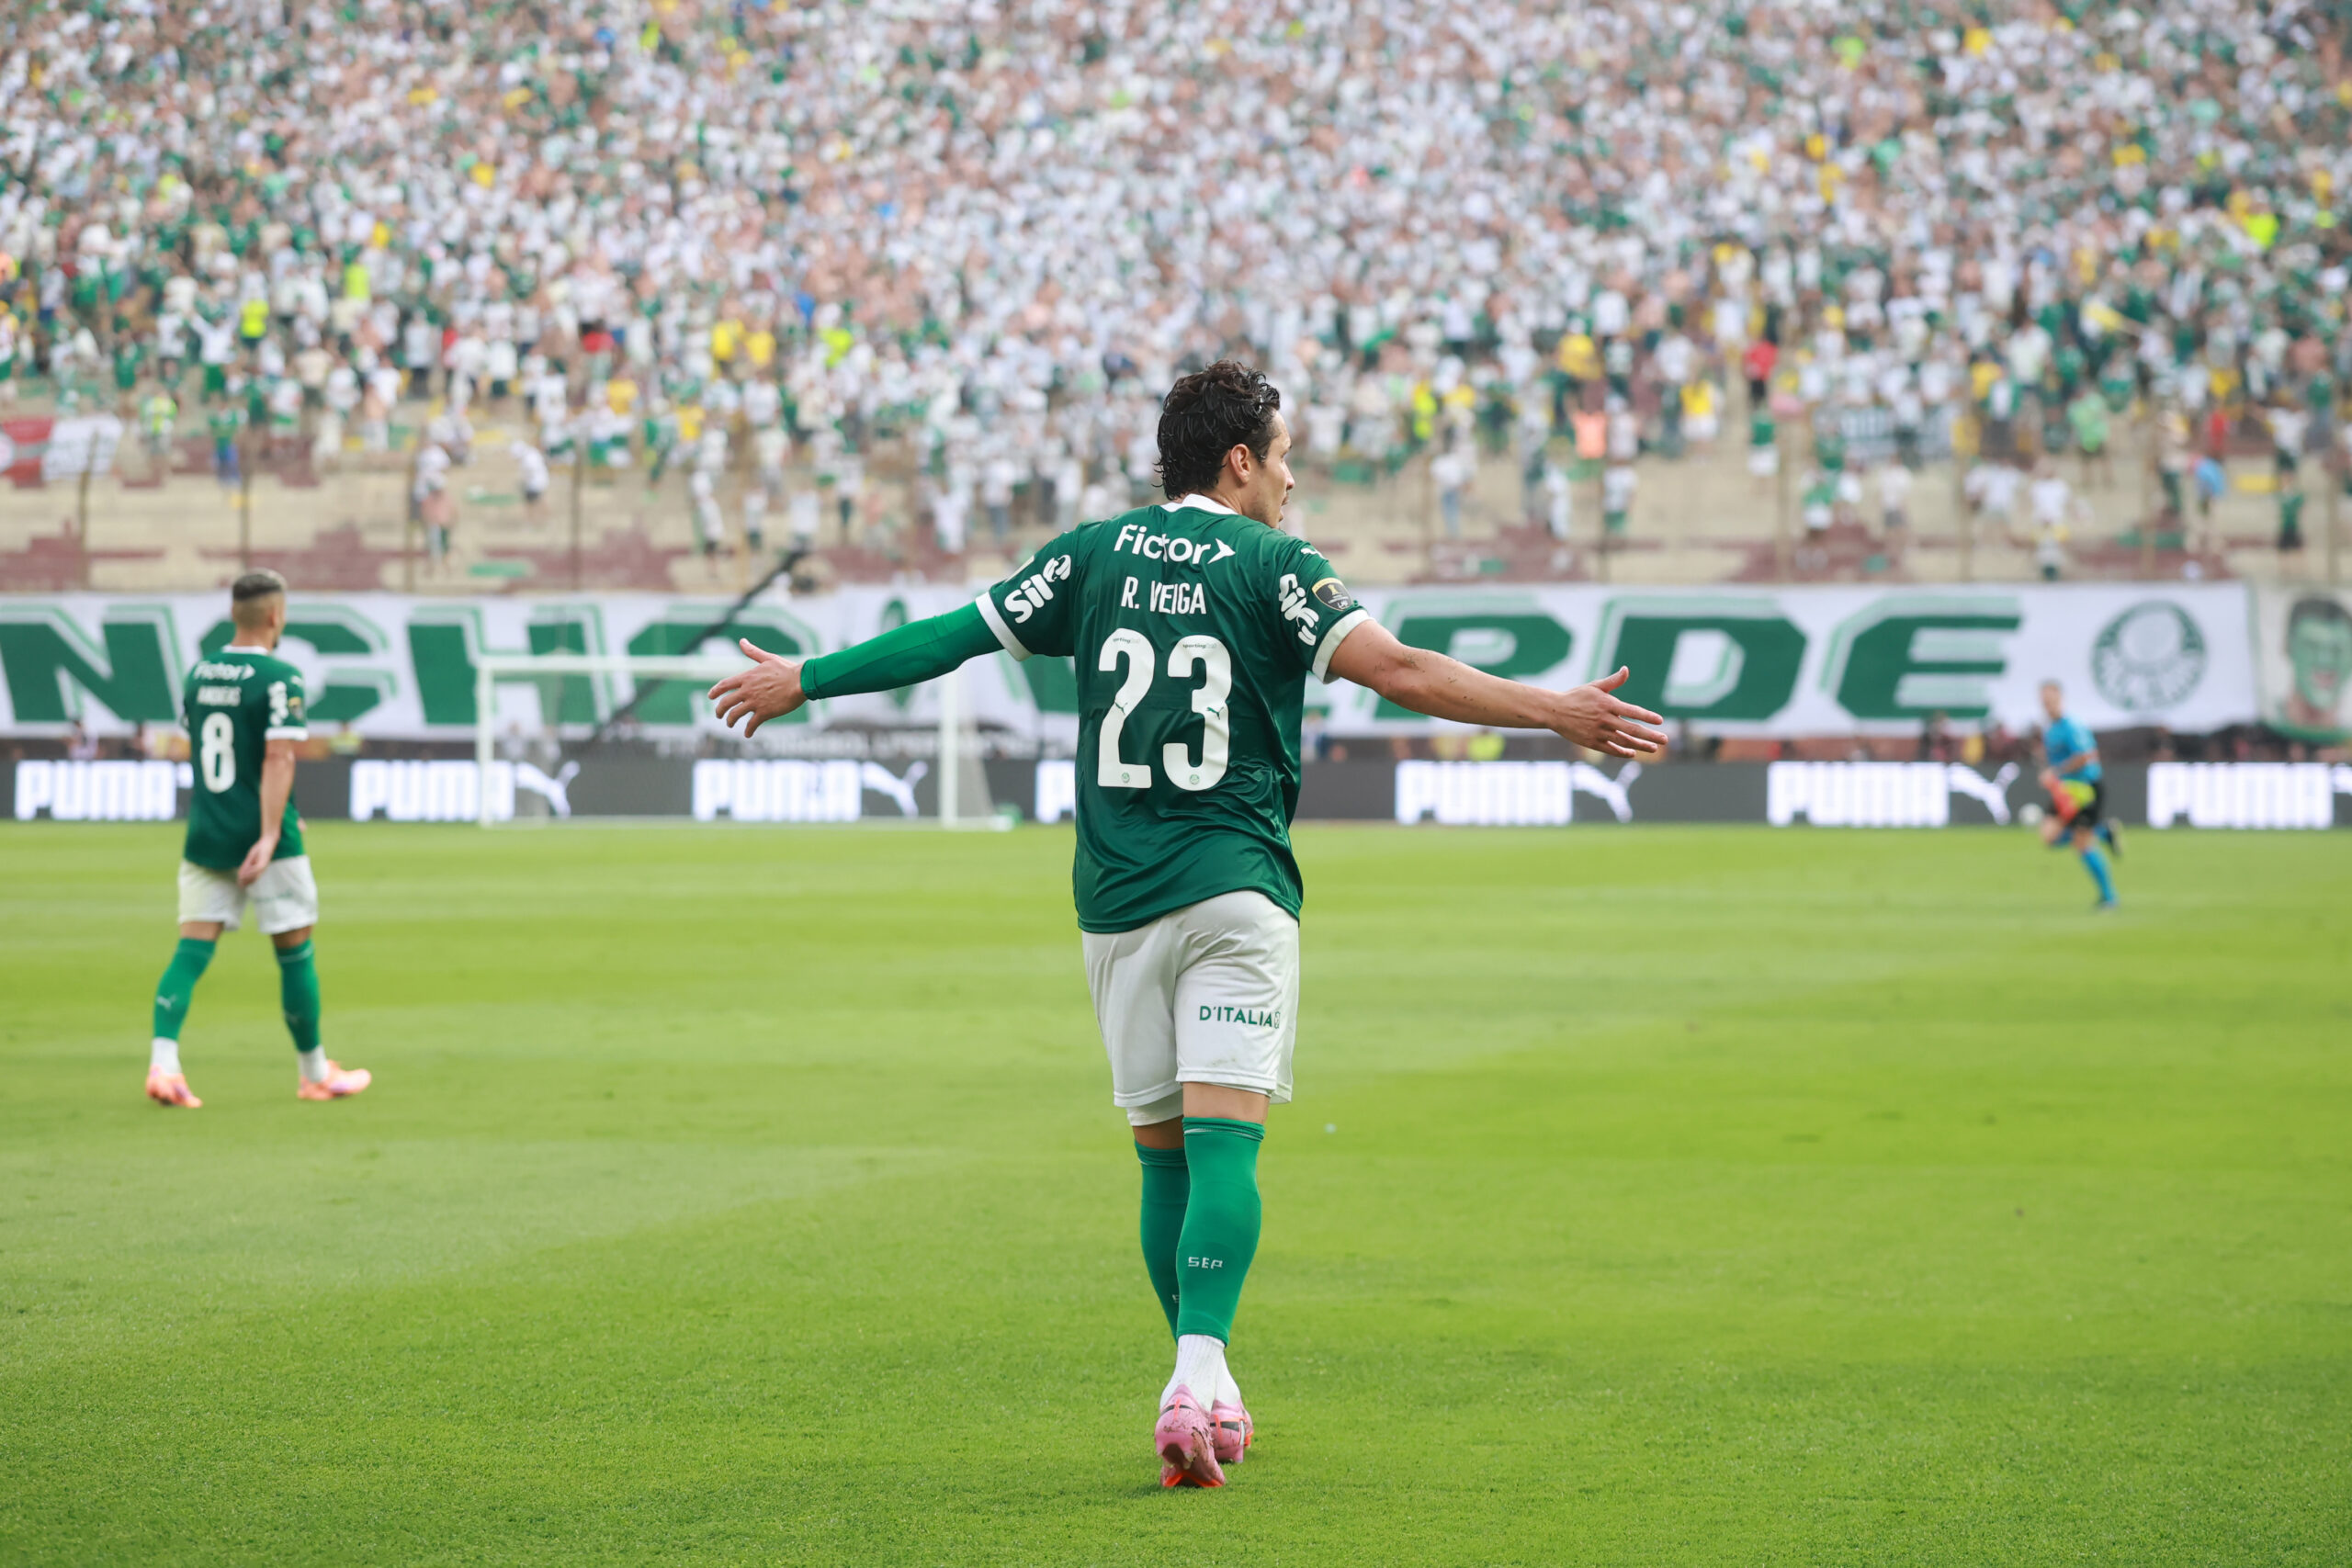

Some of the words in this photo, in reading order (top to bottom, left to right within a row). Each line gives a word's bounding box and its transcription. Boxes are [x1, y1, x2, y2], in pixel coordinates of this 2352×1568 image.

[1114, 524, 1211, 564] Fictor
[1121, 576, 1140, 610] R.
[1149, 581, 1207, 615] VEIGA
[195, 660, 243, 681] Fictor
[1098, 627, 1232, 791] 23
[200, 712, 236, 794] 8
[15, 760, 176, 820] PUMA
[349, 760, 515, 821] PUMA
[693, 759, 862, 822] PUMA
[1395, 760, 1574, 826] PUMA
[1767, 761, 1950, 827] PUMA
[2147, 761, 2334, 829] PUMA
[1199, 1005, 1272, 1028] D'ITALIA
[1188, 1256, 1223, 1269] SEP
